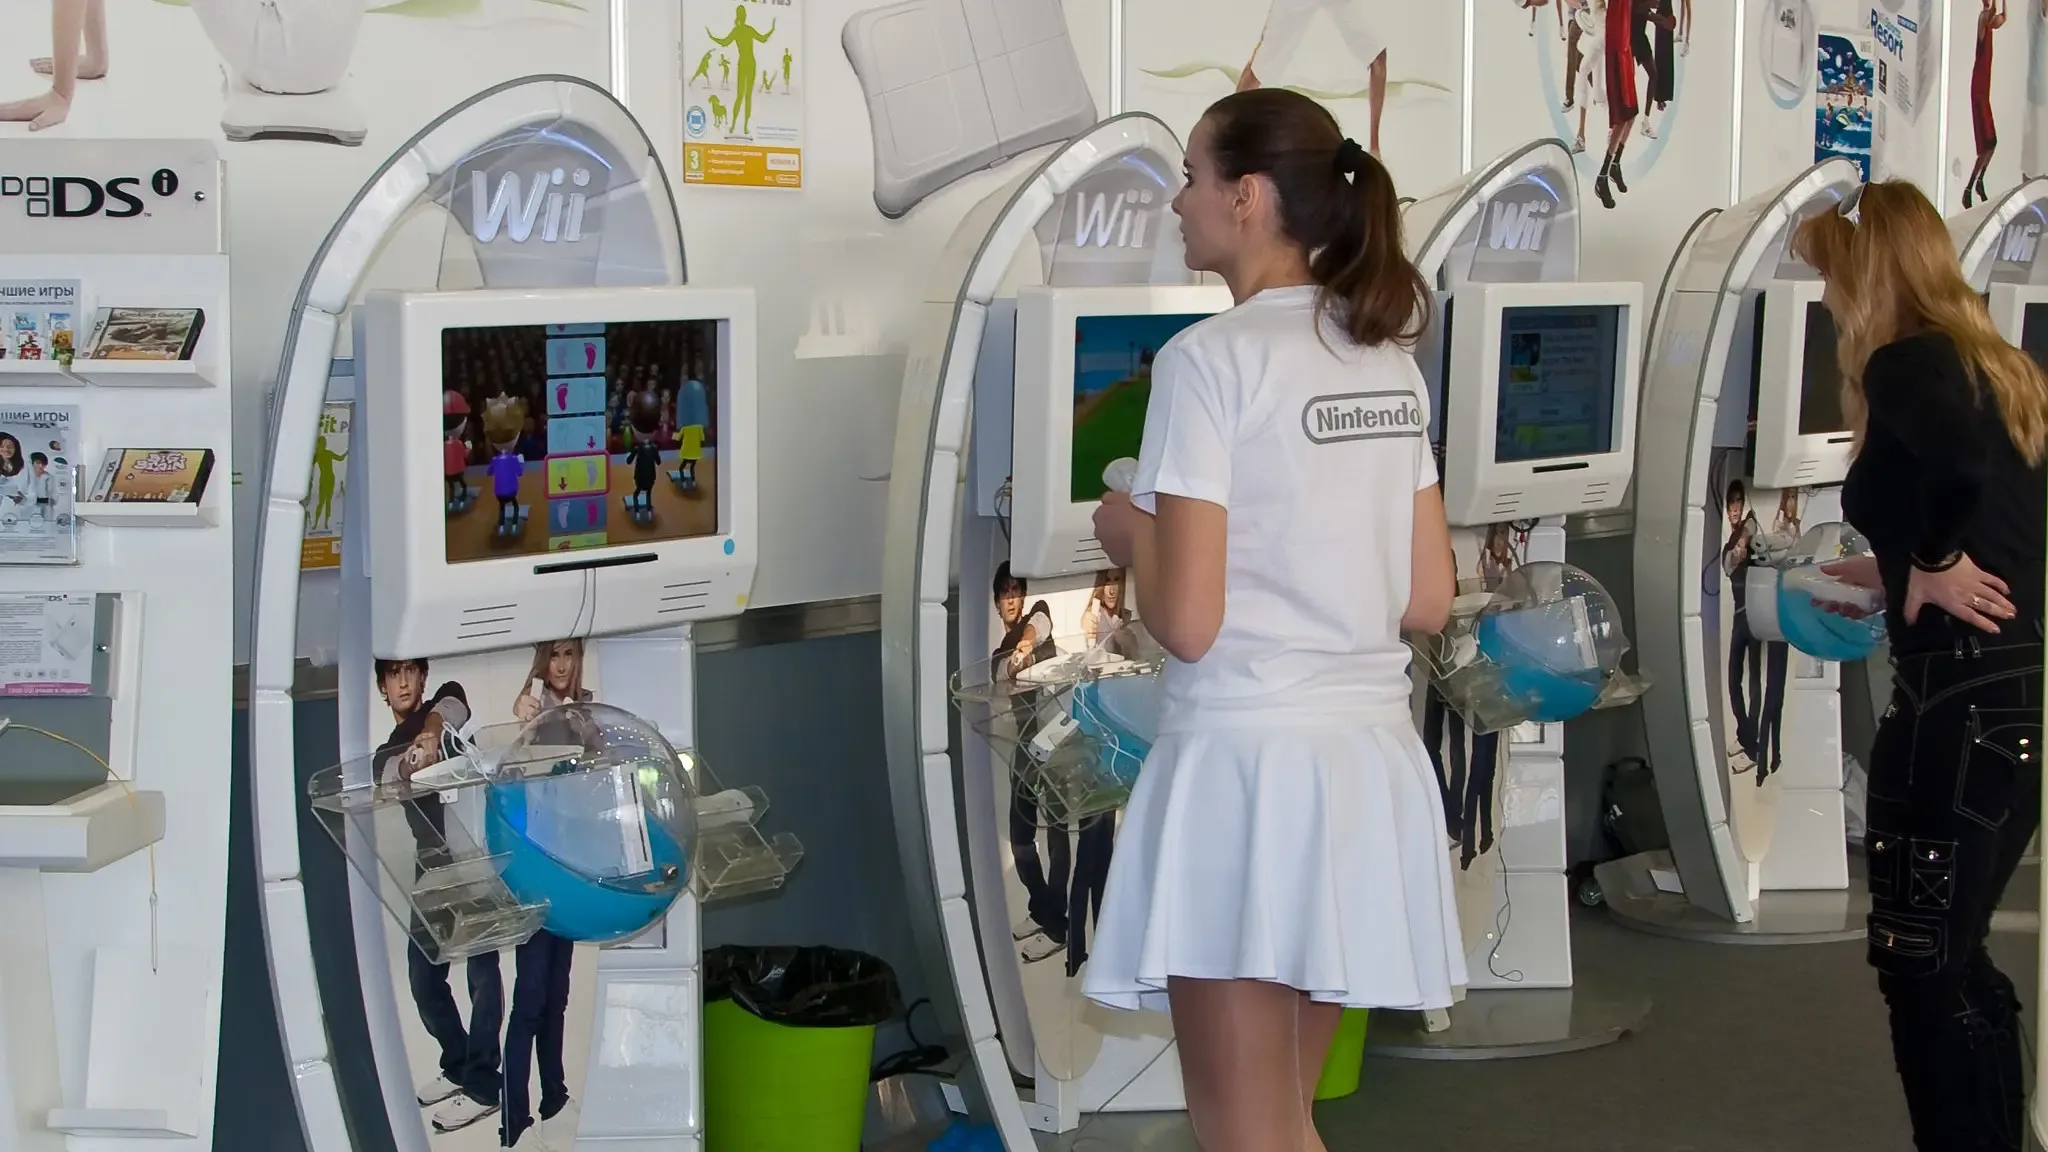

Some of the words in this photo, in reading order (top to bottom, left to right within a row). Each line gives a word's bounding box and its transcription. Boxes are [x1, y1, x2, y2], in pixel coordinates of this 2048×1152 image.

[1871, 8, 1904, 62] Resort
[689, 150, 699, 170] 3
[472, 167, 591, 243] Wii
[1075, 188, 1154, 249] Wii
[1489, 200, 1551, 251] Wii
[2002, 223, 2040, 262] Wii
[39, 286, 74, 299] игры
[1316, 402, 1421, 433] Nintendo
